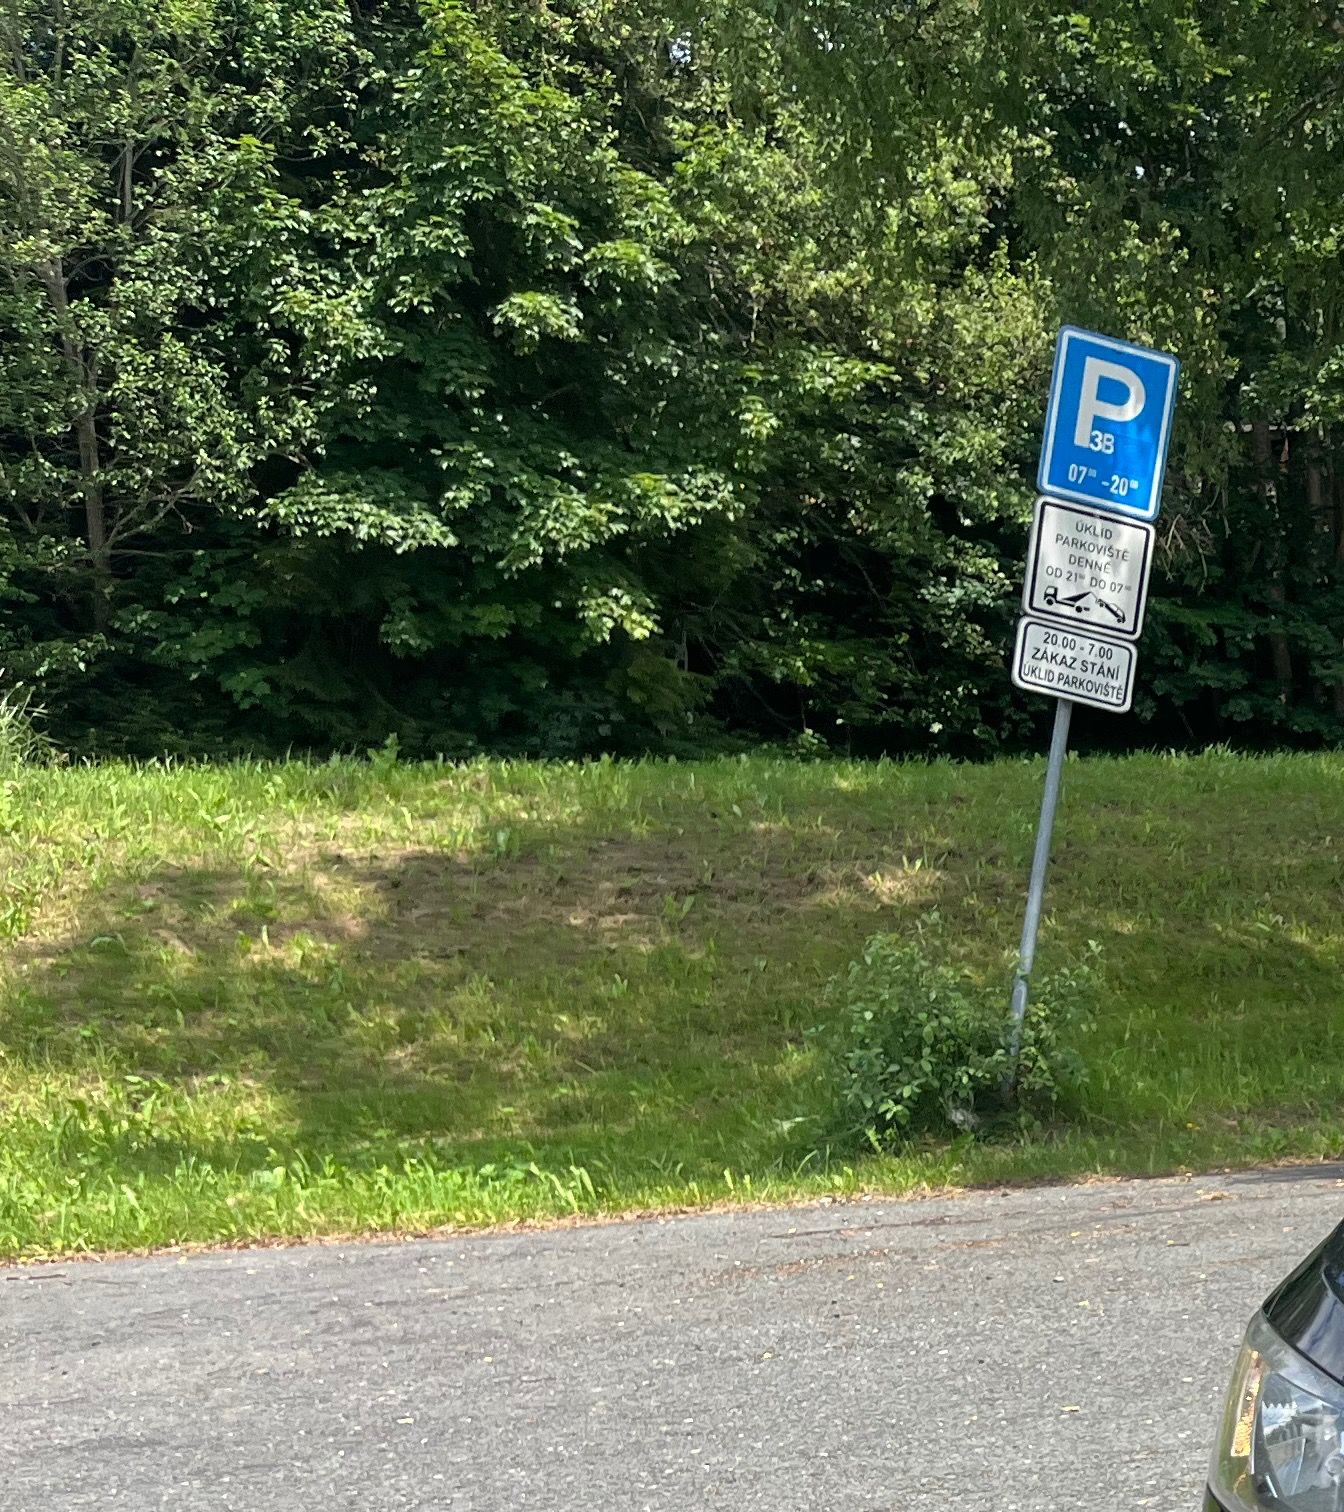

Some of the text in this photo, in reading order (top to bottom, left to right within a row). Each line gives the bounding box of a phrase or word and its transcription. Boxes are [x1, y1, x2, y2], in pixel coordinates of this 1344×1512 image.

[1074, 355, 1146, 448] P
[1045, 565, 1063, 579] OD
[1090, 576, 1106, 590] DO
[1043, 631, 1077, 651] 20.00
[1088, 643, 1113, 660] 7.00
[1031, 646, 1120, 681] ZÁKAZ STÁNÍ
